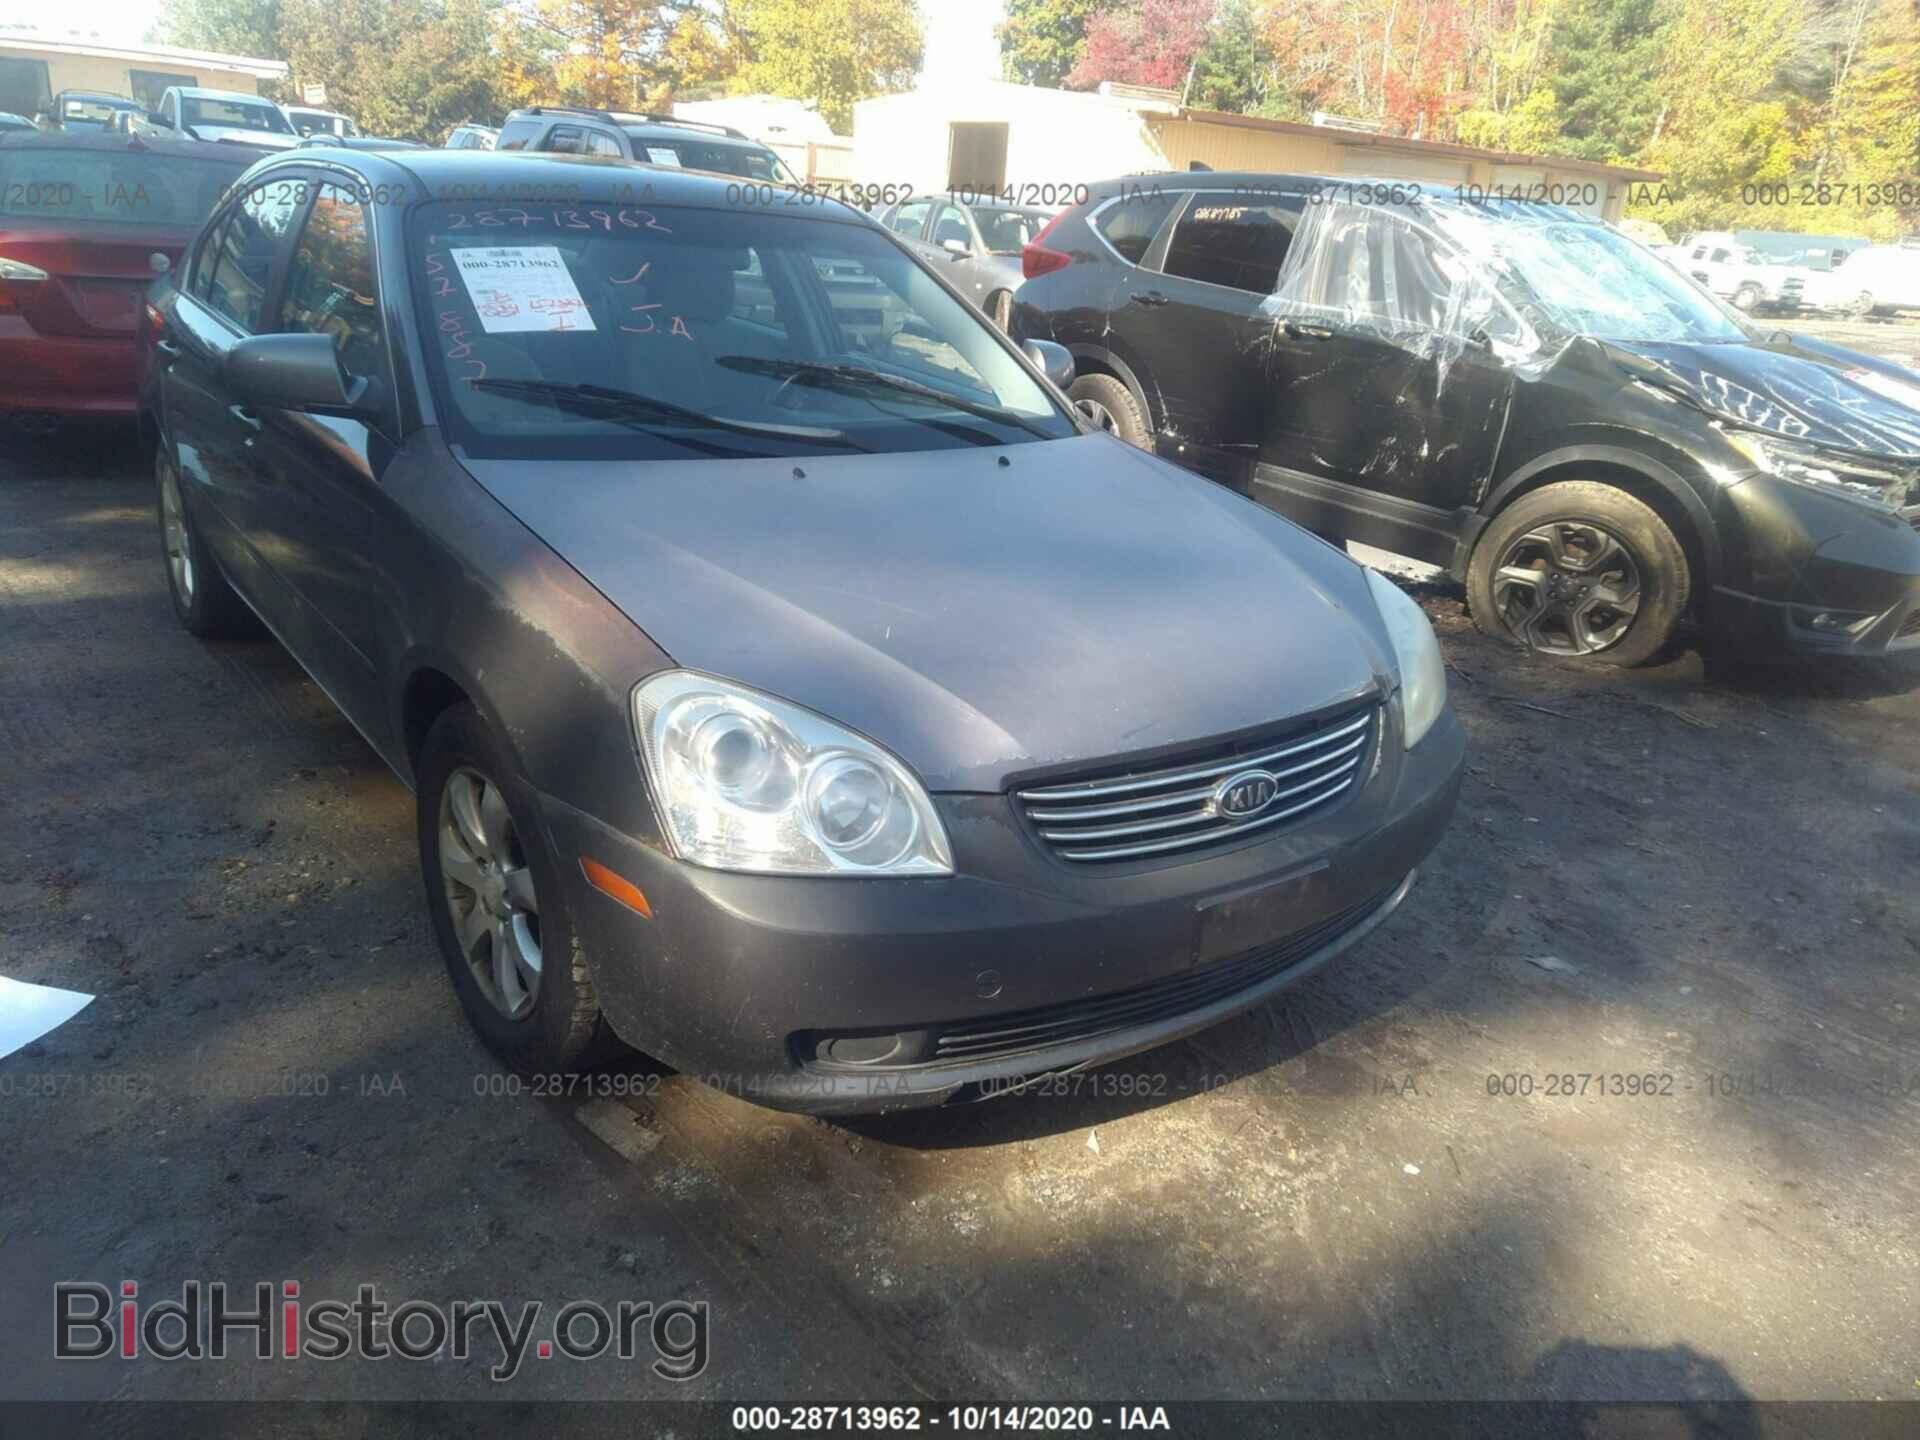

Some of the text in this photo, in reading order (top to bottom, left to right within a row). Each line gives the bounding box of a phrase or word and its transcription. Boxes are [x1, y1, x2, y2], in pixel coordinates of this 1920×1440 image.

[448, 209, 672, 233] 28713962
[463, 259, 560, 270] 000-28713962
[1229, 781, 1271, 811] KIA
